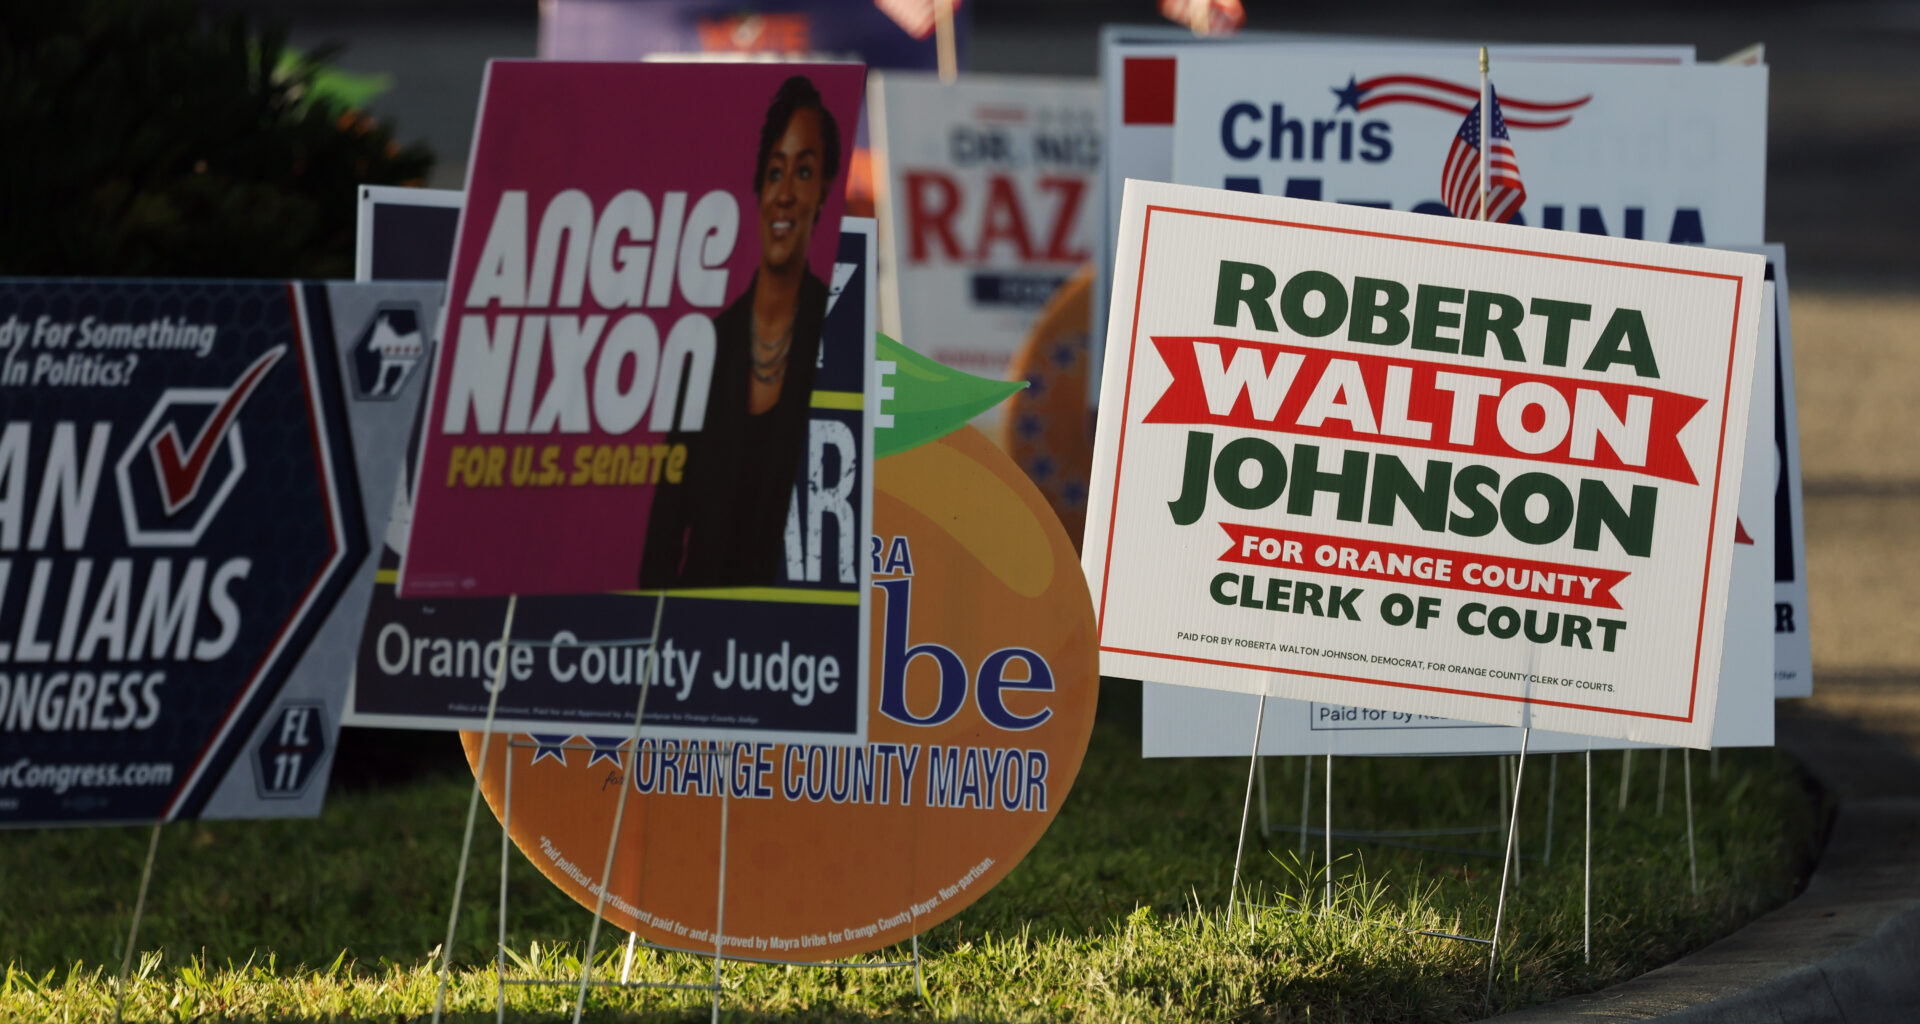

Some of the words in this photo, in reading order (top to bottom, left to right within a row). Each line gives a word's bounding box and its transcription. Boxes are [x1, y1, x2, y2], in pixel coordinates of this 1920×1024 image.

[1220, 102, 1393, 163] Chris
[31, 314, 75, 350] For
[76, 314, 218, 359] Something
[1213, 259, 1661, 379] ROBERTA
[31, 352, 141, 388] Politics?
[1192, 341, 1654, 468] WALTON
[447, 446, 507, 487] FOR
[511, 445, 565, 486] U.S.
[1167, 430, 1659, 558] JOHNSON
[1241, 535, 1304, 565] FOR
[1314, 544, 1453, 583] ORANGE
[1461, 562, 1602, 599] COUNTY
[0, 556, 252, 663] LIAMS
[1209, 572, 1365, 621] CLERK
[1380, 592, 1442, 630] OF
[1457, 602, 1627, 652] COURT
[376, 622, 535, 692] Orange
[548, 630, 701, 701] County
[712, 639, 841, 706] Judge
[873, 577, 1056, 733] be
[1176, 631, 1199, 642] PAID
[1200, 634, 1219, 645] FOR
[1220, 636, 1233, 646] BY
[1234, 638, 1277, 651] ROBERTA
[1279, 644, 1320, 657] WALTON
[1321, 649, 1369, 663] JOHNSON,
[1370, 655, 1425, 671] DEMOCRAT,
[1427, 661, 1447, 672] FOR
[1447, 664, 1488, 677] ORANGE
[1488, 669, 1529, 682] COUNTY
[1529, 674, 1559, 686] CLERK
[1560, 678, 1574, 688] OF
[1575, 680, 1616, 693] COURTS.
[280, 708, 310, 747] FL
[1319, 706, 1357, 721] Paid
[0, 757, 174, 796] rCongress.com
[272, 753, 302, 791] 11
[634, 736, 773, 798] ORANGE
[782, 742, 921, 806] COUNTY
[926, 745, 1048, 811] MAYOR
[555, 855, 591, 887] political
[588, 882, 652, 921] adertisement
[651, 915, 674, 932] paid
[674, 922, 688, 937] for
[689, 929, 709, 943] and
[755, 936, 768, 952] by
[770, 936, 800, 951] Mayra
[801, 933, 827, 948] Uribe
[828, 931, 843, 945] for
[844, 923, 878, 941] Orange
[877, 910, 912, 932] County
[910, 895, 942, 917] Mayor.
[937, 856, 996, 901] Non-partisan.
